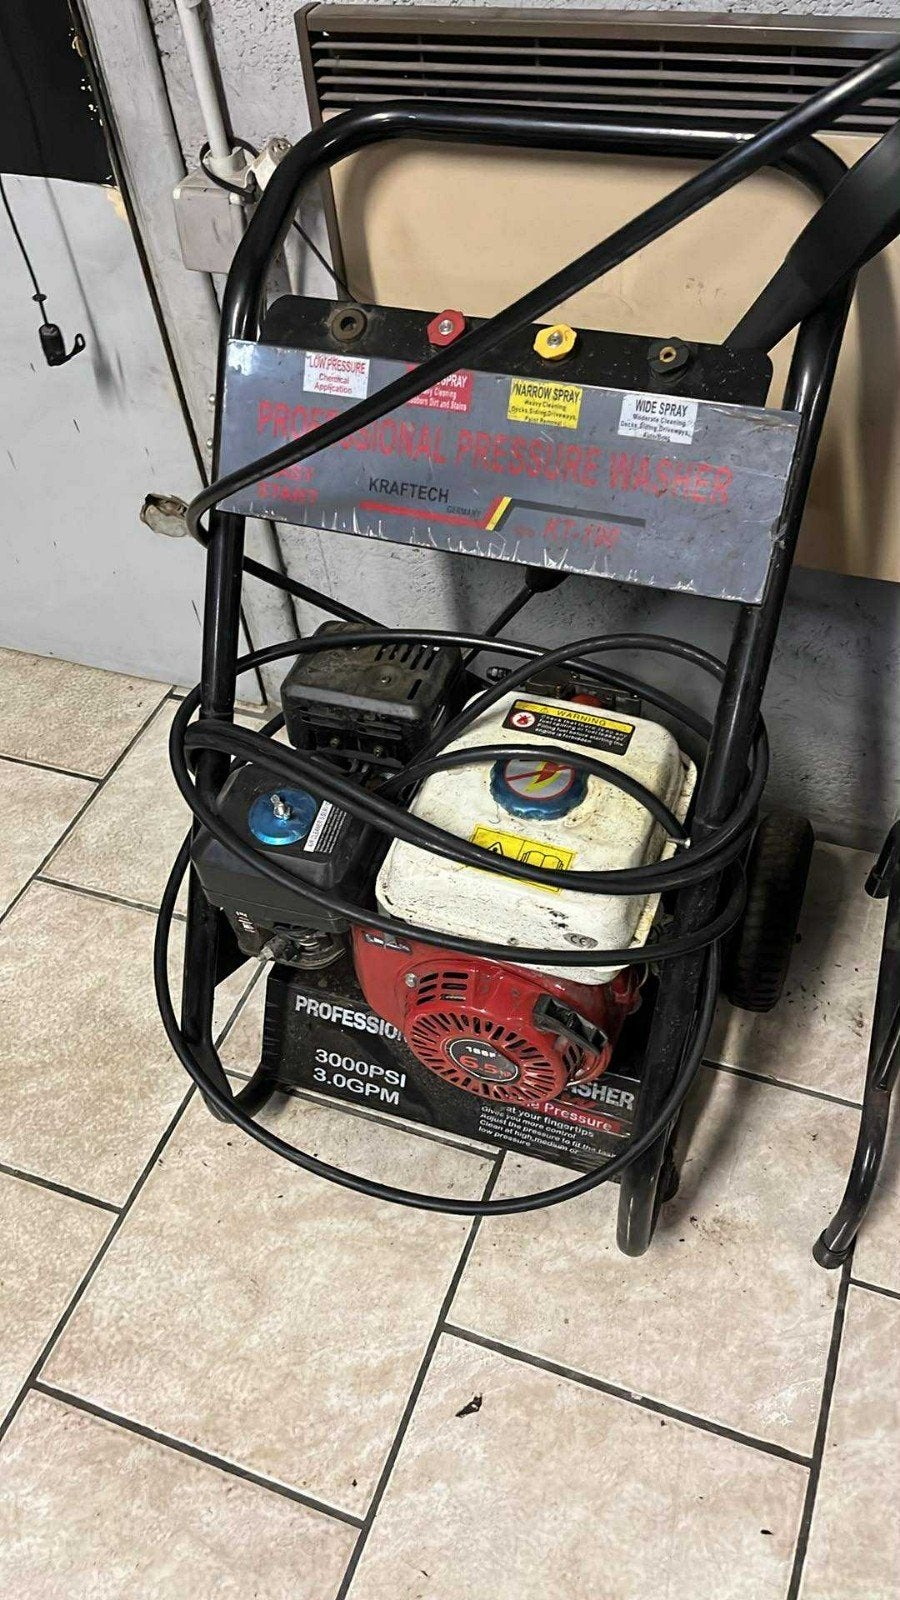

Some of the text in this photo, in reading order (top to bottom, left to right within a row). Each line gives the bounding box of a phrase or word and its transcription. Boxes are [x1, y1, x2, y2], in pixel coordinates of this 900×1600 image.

[310, 355, 366, 375] LOW PRESSURE
[313, 382, 352, 394] Application
[318, 372, 350, 384] Chemical
[514, 383, 580, 404] NARROW SPRAY
[635, 399, 688, 417] WIDE SPRAY
[660, 417, 686, 428] Cleaning
[274, 465, 316, 484] AST
[454, 428, 600, 488] PRESSURE
[608, 451, 734, 504] WASHER
[368, 477, 450, 503] KRAFTECH
[556, 710, 607, 726] WARNING
[314, 1048, 408, 1088] 3000PSI
[312, 1067, 400, 1106] 3.0GPM
[505, 1106, 516, 1114] at
[518, 1110, 542, 1121] your
[544, 1116, 594, 1138] fingertips
[505, 1114, 521, 1123] you
[522, 1119, 544, 1130] more
[545, 1126, 576, 1139] control
[544, 1102, 613, 1132] Pressure
[478, 1126, 531, 1147] low pressure
[479, 1119, 503, 1131] Clean
[505, 1127, 514, 1135] at
[569, 1147, 579, 1155] or
[480, 1113, 507, 1125] Adjust
[508, 1121, 522, 1130] the
[522, 1126, 561, 1142] pressure
[561, 1137, 571, 1145] to
[571, 1140, 581, 1149] fit
